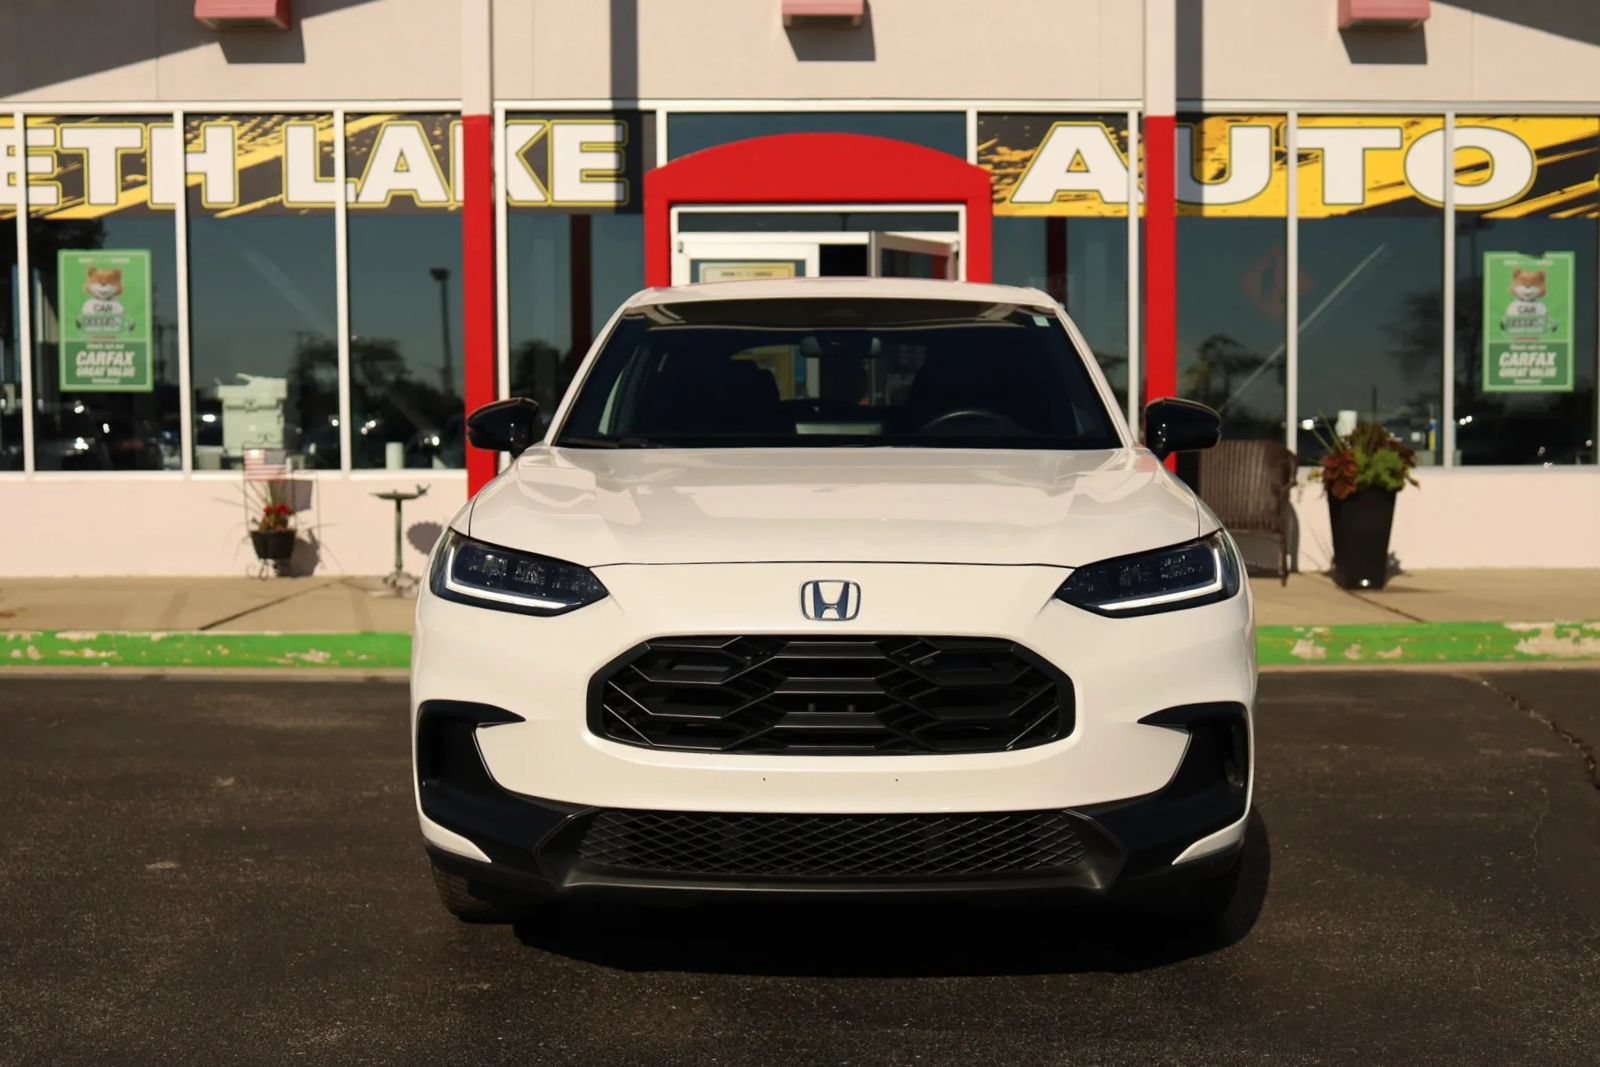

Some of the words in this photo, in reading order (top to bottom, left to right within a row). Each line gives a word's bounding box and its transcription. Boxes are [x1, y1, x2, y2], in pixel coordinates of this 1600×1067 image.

[283, 121, 628, 208] LAKE
[1009, 121, 1537, 210] AUTO
[76, 350, 135, 366] CARFAX
[1498, 351, 1557, 366] CARFAX
